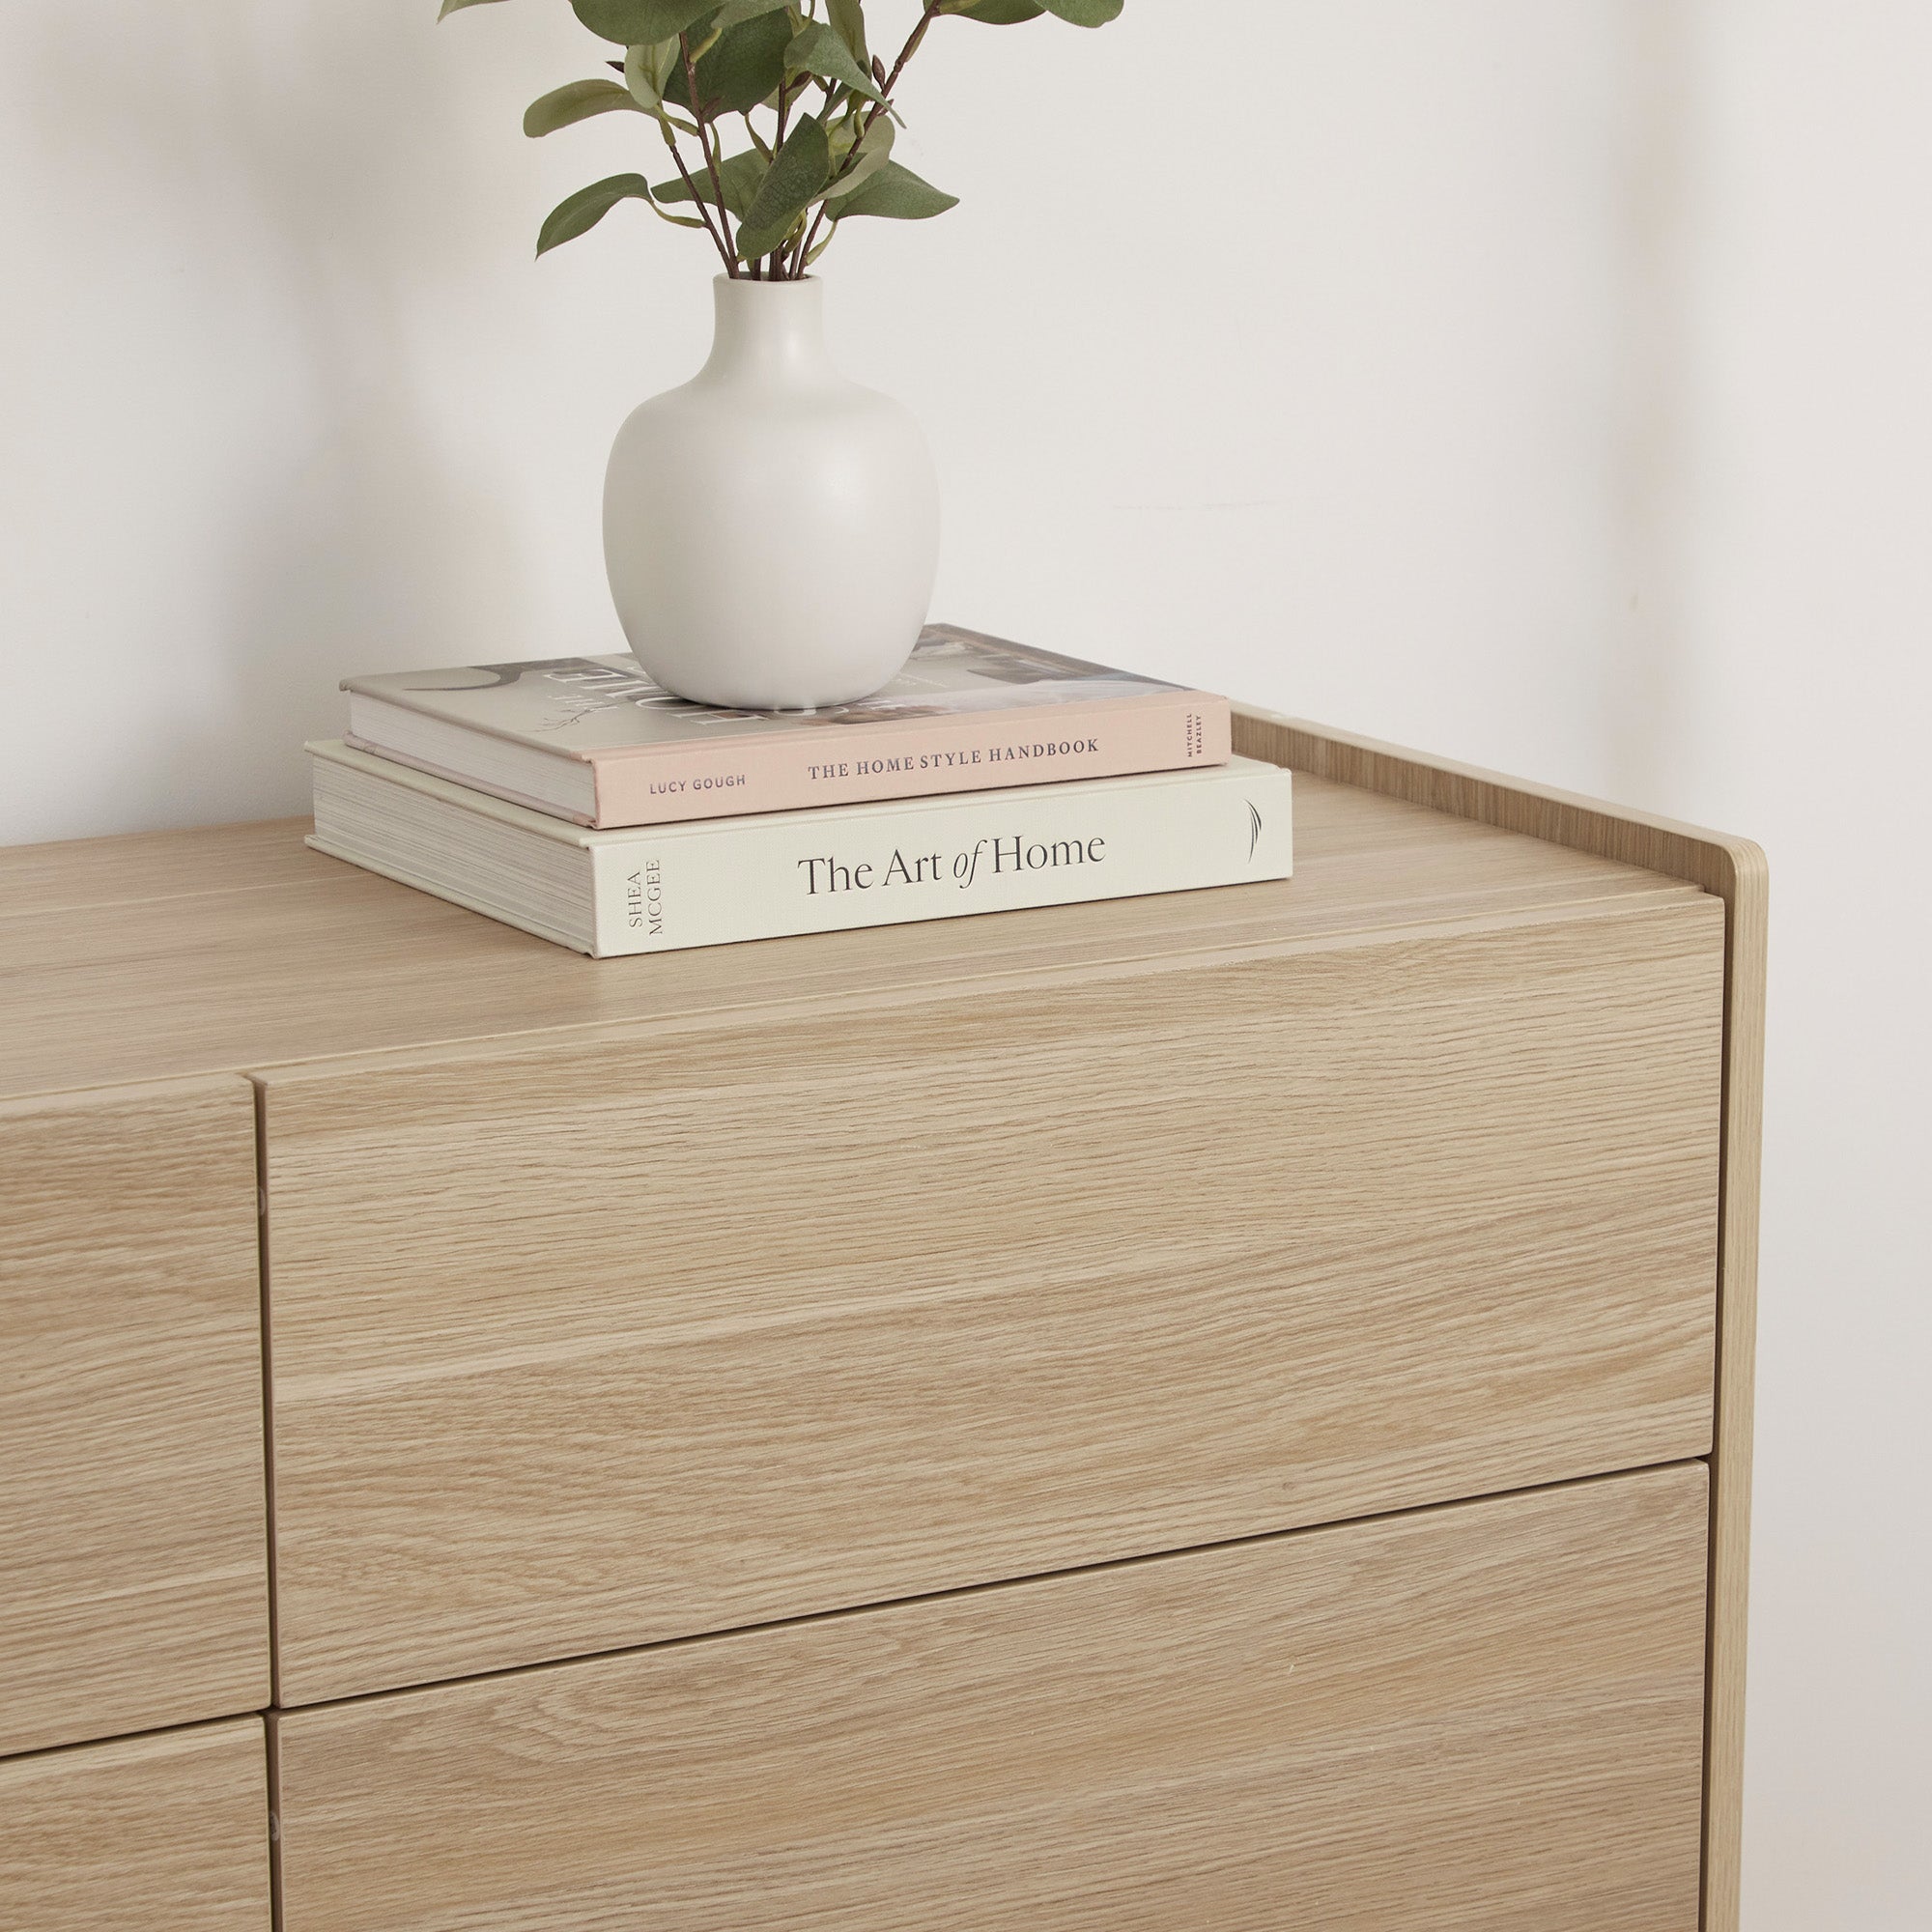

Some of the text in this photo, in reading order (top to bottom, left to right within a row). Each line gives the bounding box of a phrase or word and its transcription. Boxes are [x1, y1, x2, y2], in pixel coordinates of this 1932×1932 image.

[650, 774, 746, 795] LUCY GOUGH
[808, 737, 1099, 781] THE HOME STYLE HANDBOOK
[797, 835, 1106, 895] The Art of Home
[627, 871, 643, 928] SHEA
[645, 859, 664, 936] MCGEE
